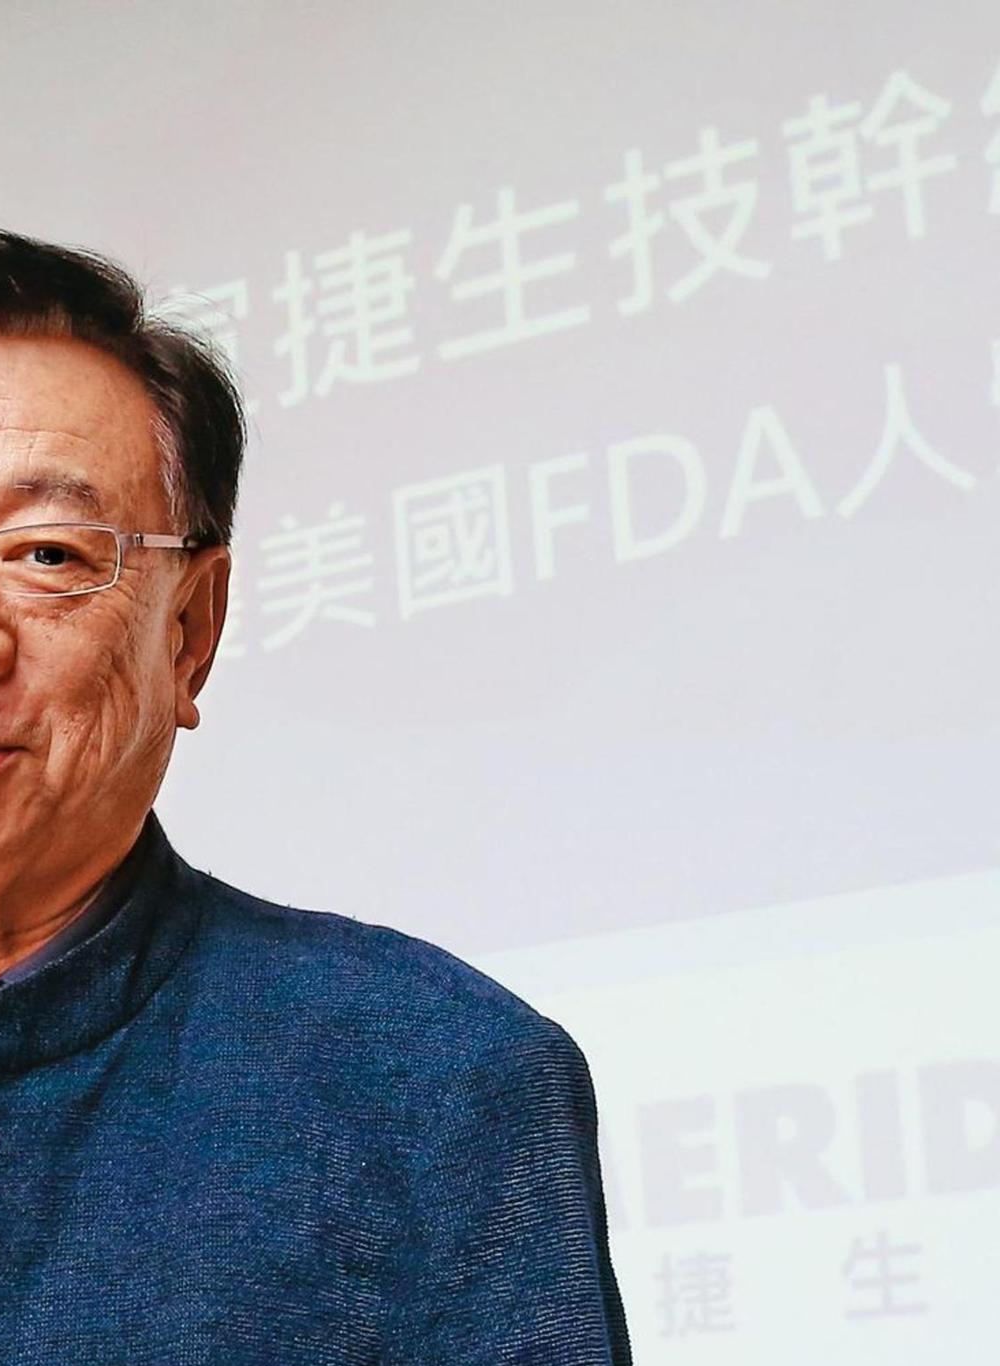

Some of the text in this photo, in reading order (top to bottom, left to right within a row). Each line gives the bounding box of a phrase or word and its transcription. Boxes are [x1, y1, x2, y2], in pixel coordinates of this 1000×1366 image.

[150, 60, 1000, 413] 捷生技幹
[221, 338, 1000, 658] 美國FDA人
[597, 1059, 1000, 1232] ERID
